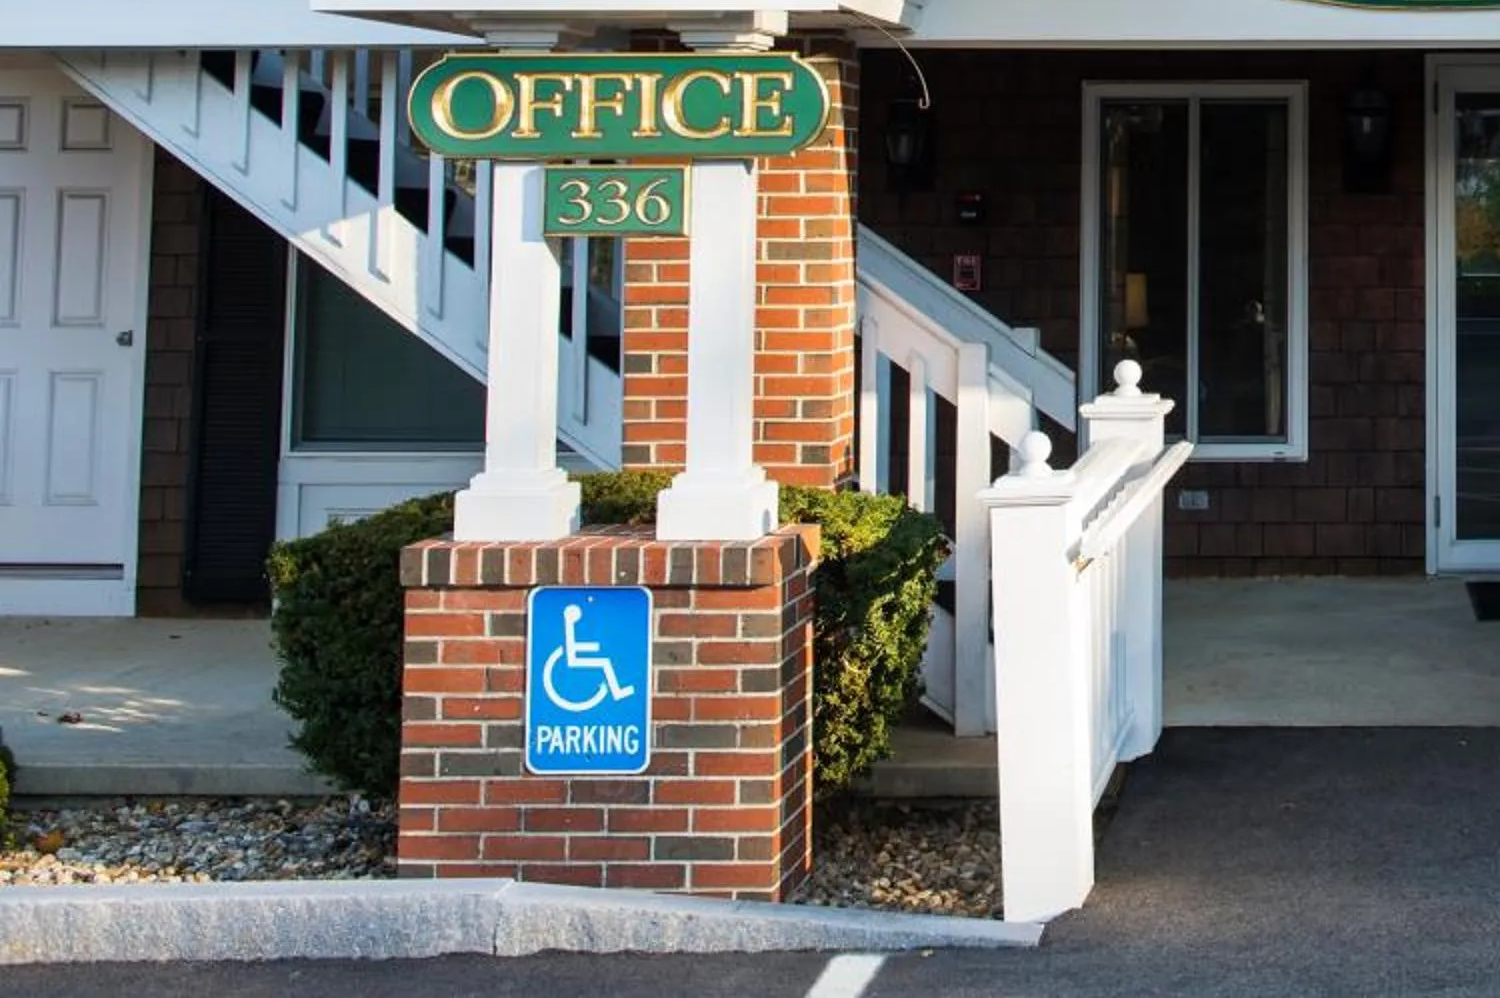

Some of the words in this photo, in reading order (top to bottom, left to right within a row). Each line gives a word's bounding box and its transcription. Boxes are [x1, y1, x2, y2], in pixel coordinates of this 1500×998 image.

[431, 71, 794, 139] OFFICE
[557, 177, 672, 225] 336
[536, 725, 640, 755] PARKING
